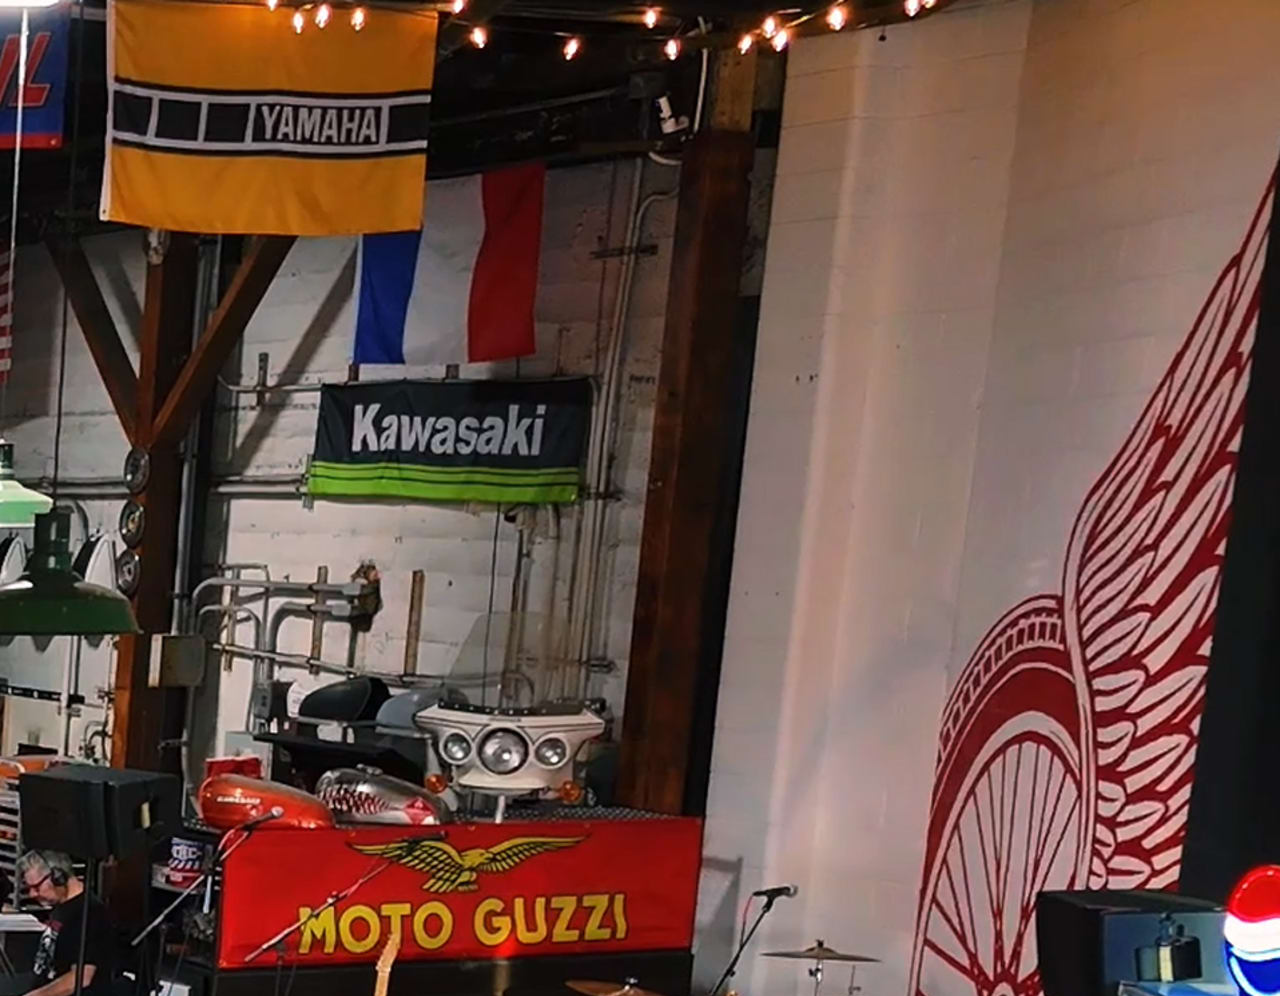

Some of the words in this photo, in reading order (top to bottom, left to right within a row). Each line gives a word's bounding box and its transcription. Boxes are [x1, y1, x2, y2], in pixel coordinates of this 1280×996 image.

[261, 104, 377, 144] YAMAHA
[351, 403, 547, 456] Kawasaki
[297, 899, 454, 955] MOTO
[473, 893, 629, 945] GUZZI
